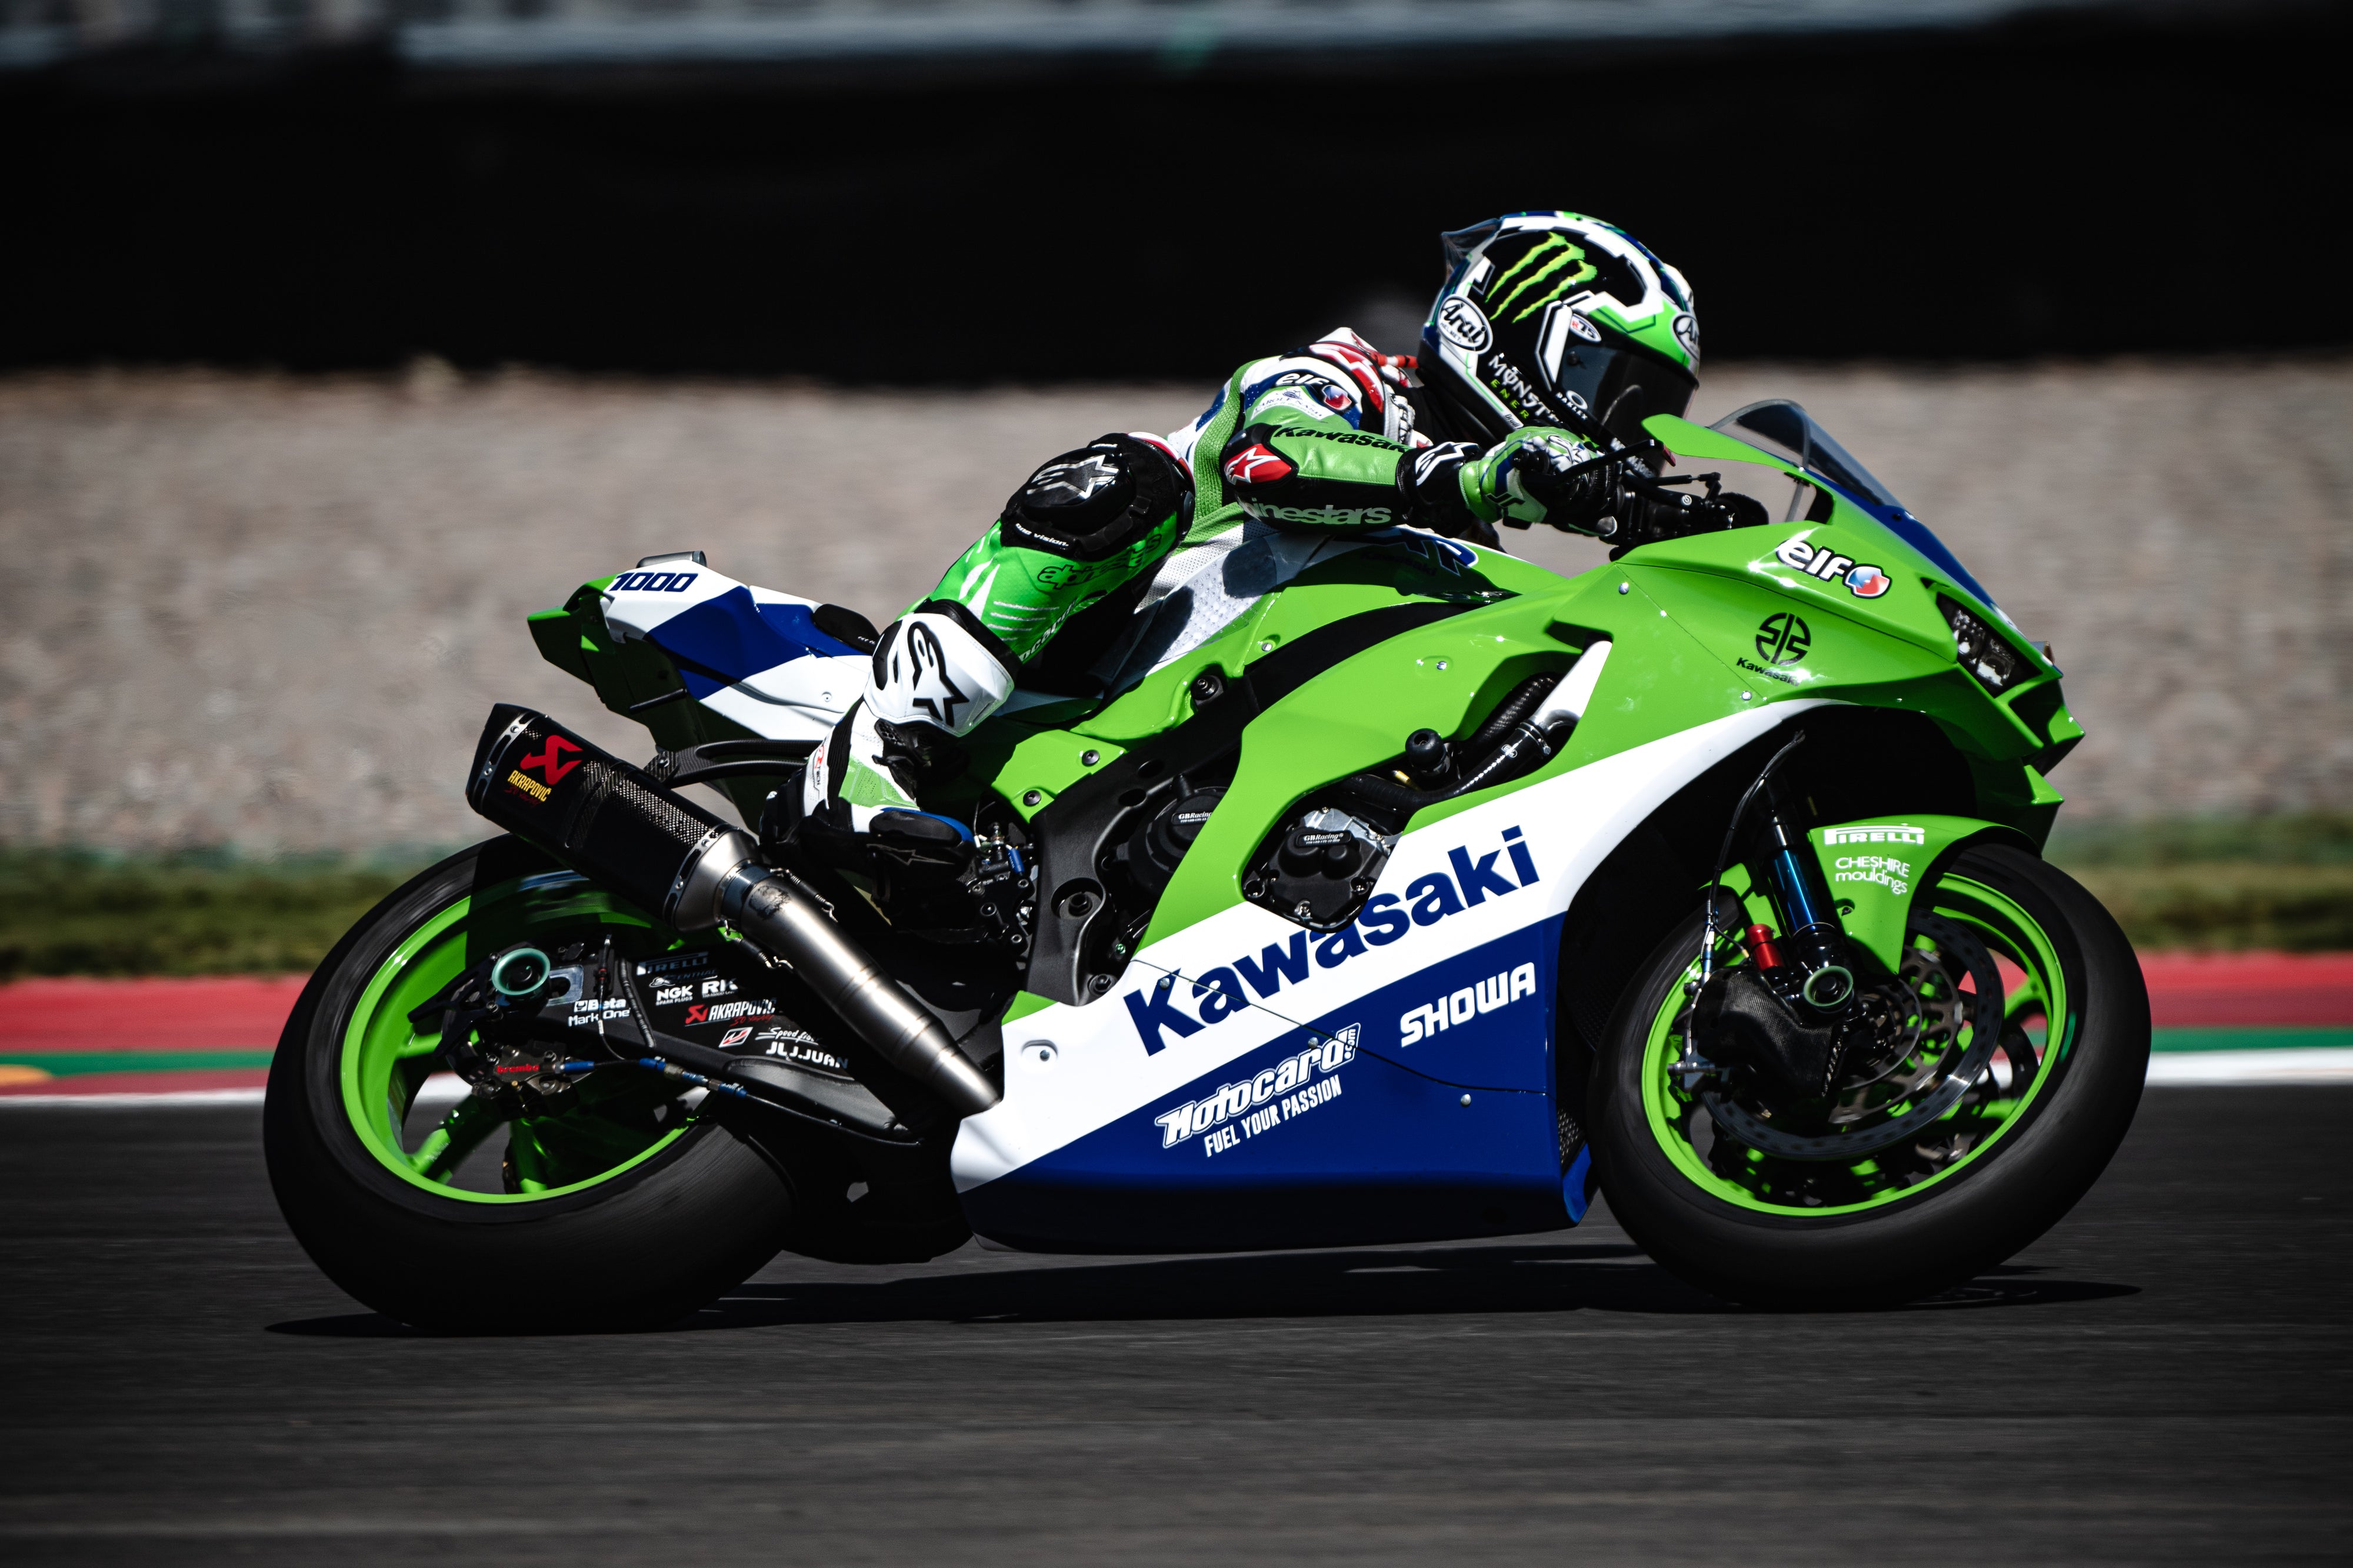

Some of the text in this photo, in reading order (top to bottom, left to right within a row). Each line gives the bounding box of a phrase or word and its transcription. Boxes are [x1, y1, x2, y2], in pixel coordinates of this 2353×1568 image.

[1441, 302, 1487, 343] Arai
[1556, 392, 1588, 420] OAKLEY
[1015, 523, 1032, 535] one
[1778, 540, 1854, 580] elf
[609, 572, 699, 592] 1000
[1824, 825, 1925, 845] PIRELLI
[1835, 856, 1911, 878] CHESHIRE
[1835, 869, 1908, 895] mouldings
[1123, 825, 1540, 1057] Kawasaki
[656, 985, 694, 1002] NGK
[702, 979, 738, 995] RK
[587, 997, 626, 1012] Beta
[1400, 962, 1537, 1048] SHOWA
[568, 1012, 599, 1027] Mark
[1204, 1074, 1342, 1157] FUEL YOUR PASSION
